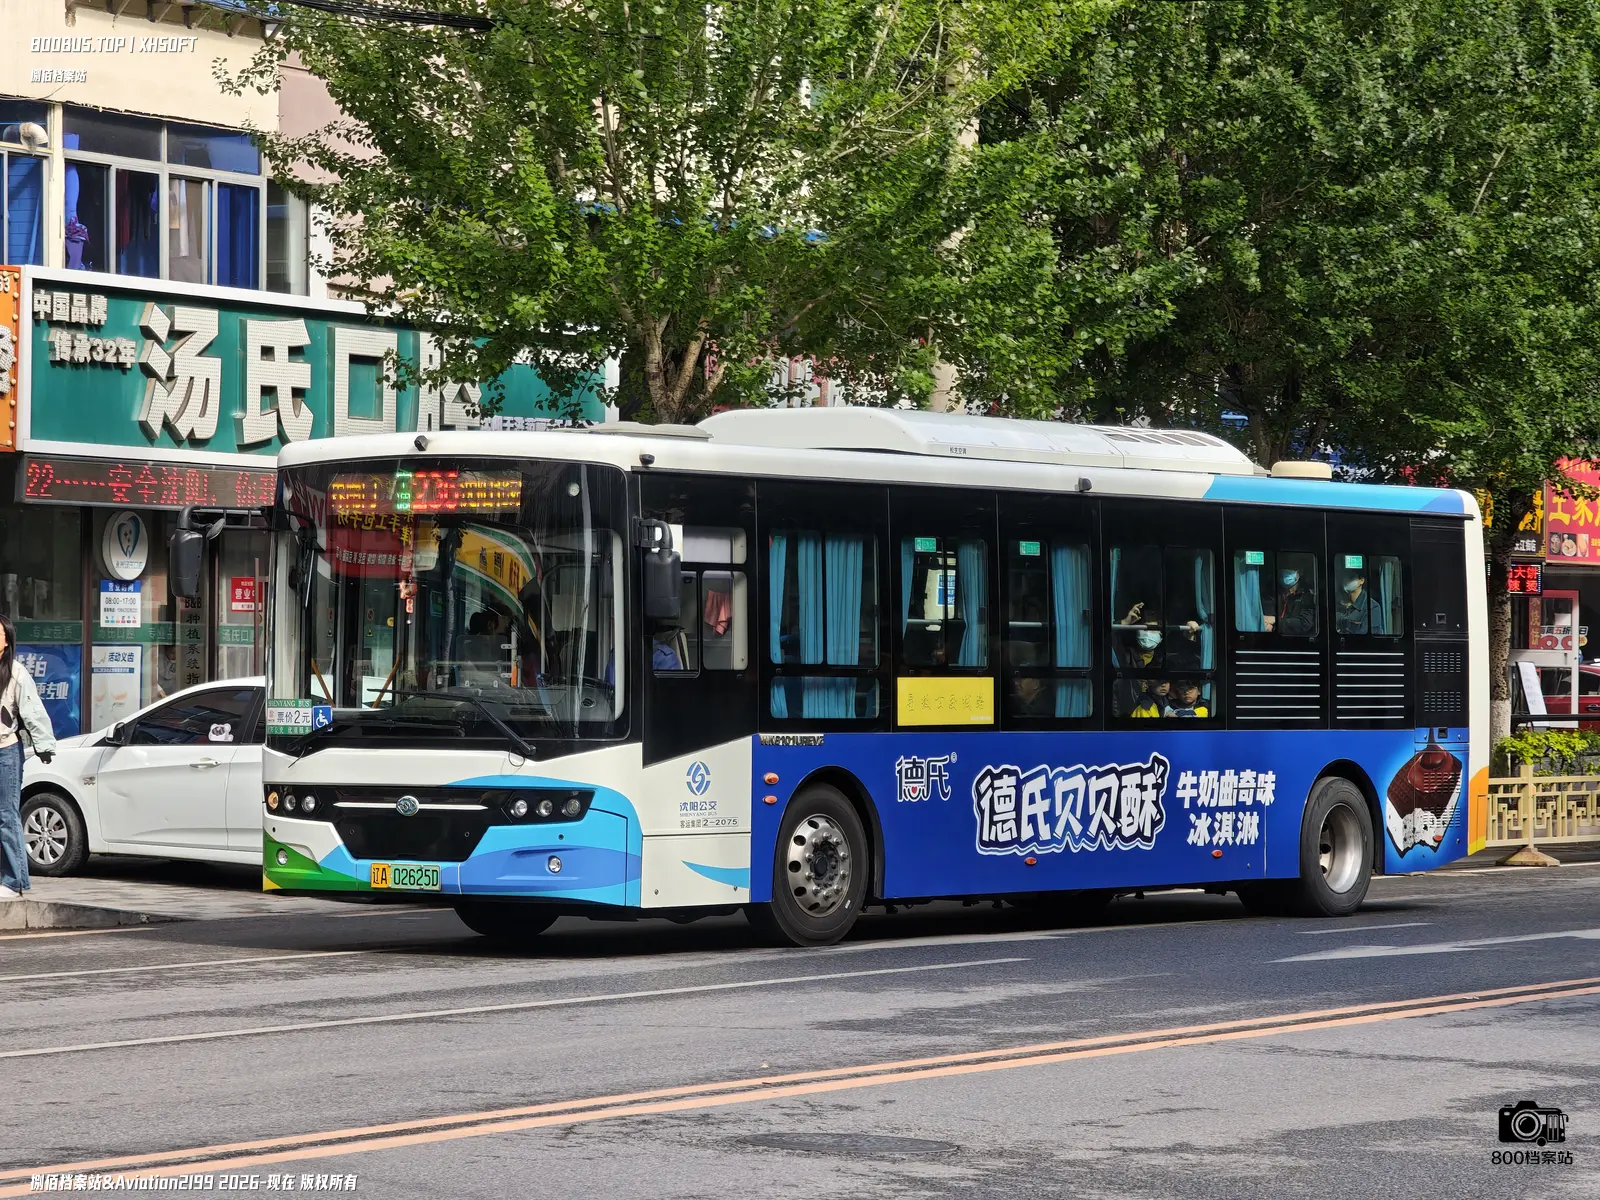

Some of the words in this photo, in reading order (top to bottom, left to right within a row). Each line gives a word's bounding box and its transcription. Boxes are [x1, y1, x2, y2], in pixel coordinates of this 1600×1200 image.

[33, 289, 108, 326] 中国品牌
[53, 330, 136, 368] 传承32年
[108, 582, 134, 592] 营业时间
[222, 629, 255, 642] 汤氏口
[108, 652, 135, 663] 活动义齿
[277, 710, 311, 724] 票价2元
[896, 755, 952, 803] 德氏
[1176, 770, 1277, 809] 牛奶曲奇味
[680, 800, 718, 812] 沈阳公交
[978, 765, 1165, 843] 德氏贝贝酥
[680, 819, 702, 829] 客运集团
[703, 818, 738, 827] 2-2075
[1186, 811, 1260, 847] 冰淇淋
[372, 867, 388, 885] 辽A
[393, 868, 439, 887] 02625D
